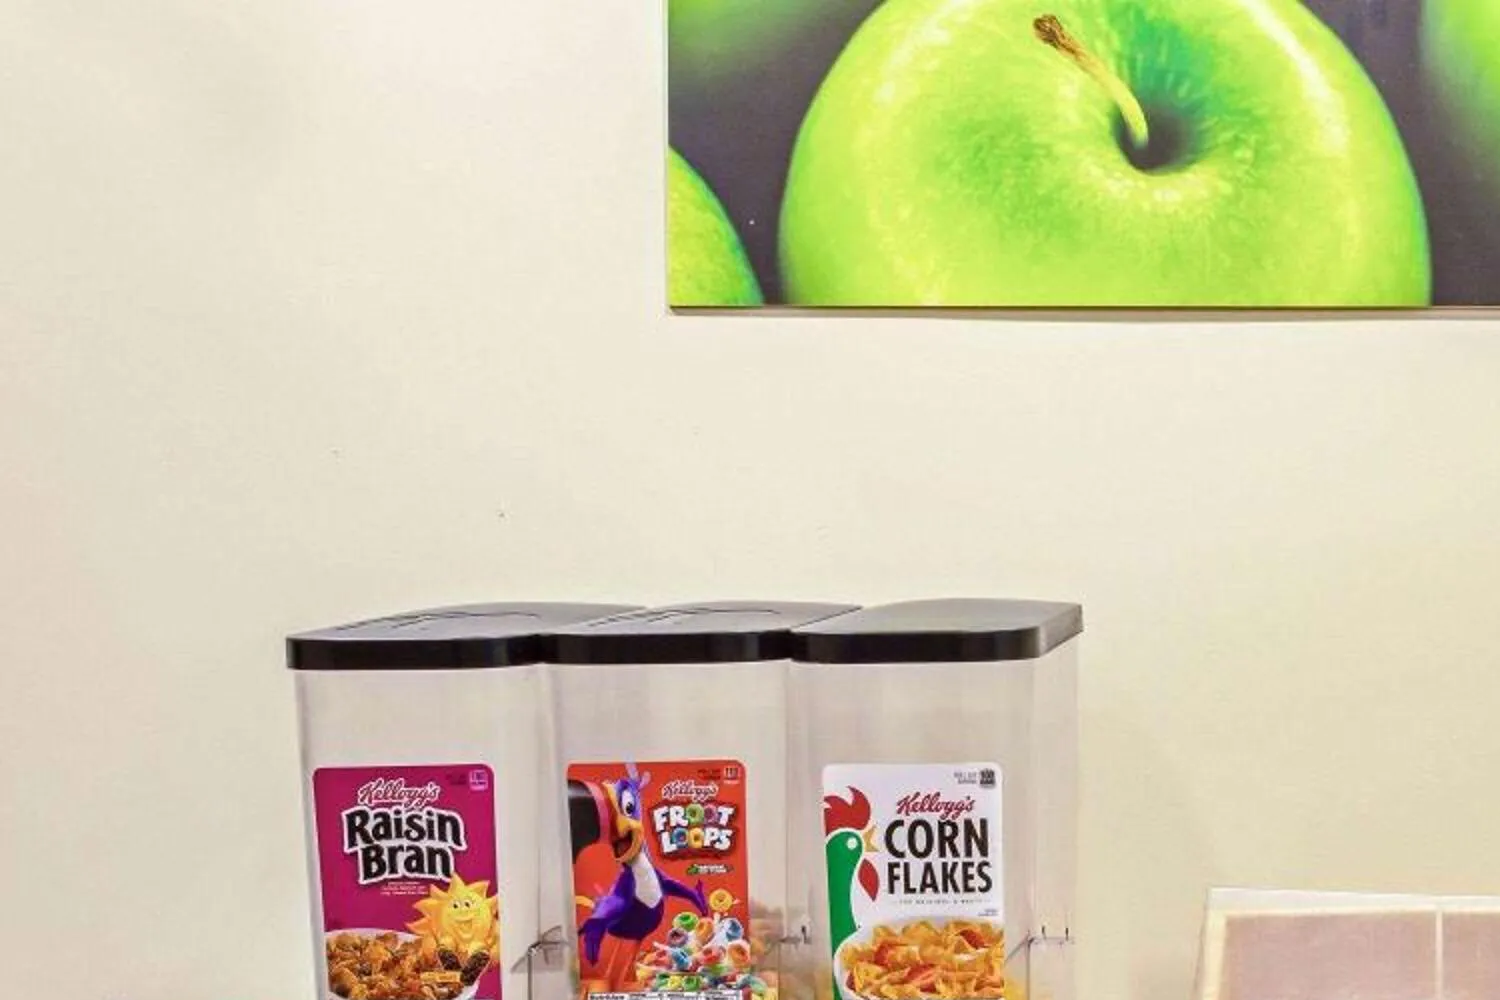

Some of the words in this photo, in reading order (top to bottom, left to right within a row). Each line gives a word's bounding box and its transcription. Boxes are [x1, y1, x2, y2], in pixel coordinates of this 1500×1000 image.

[358, 778, 440, 808] Kellogg's
[662, 780, 718, 801] Kellogg's
[896, 791, 976, 820] Kellogg's
[345, 808, 464, 850] Raisin
[653, 803, 734, 832] FROOT
[661, 827, 732, 853] LOOPS
[884, 818, 989, 859] CORN
[361, 844, 452, 880] Bran
[887, 860, 993, 894] FLAKES
